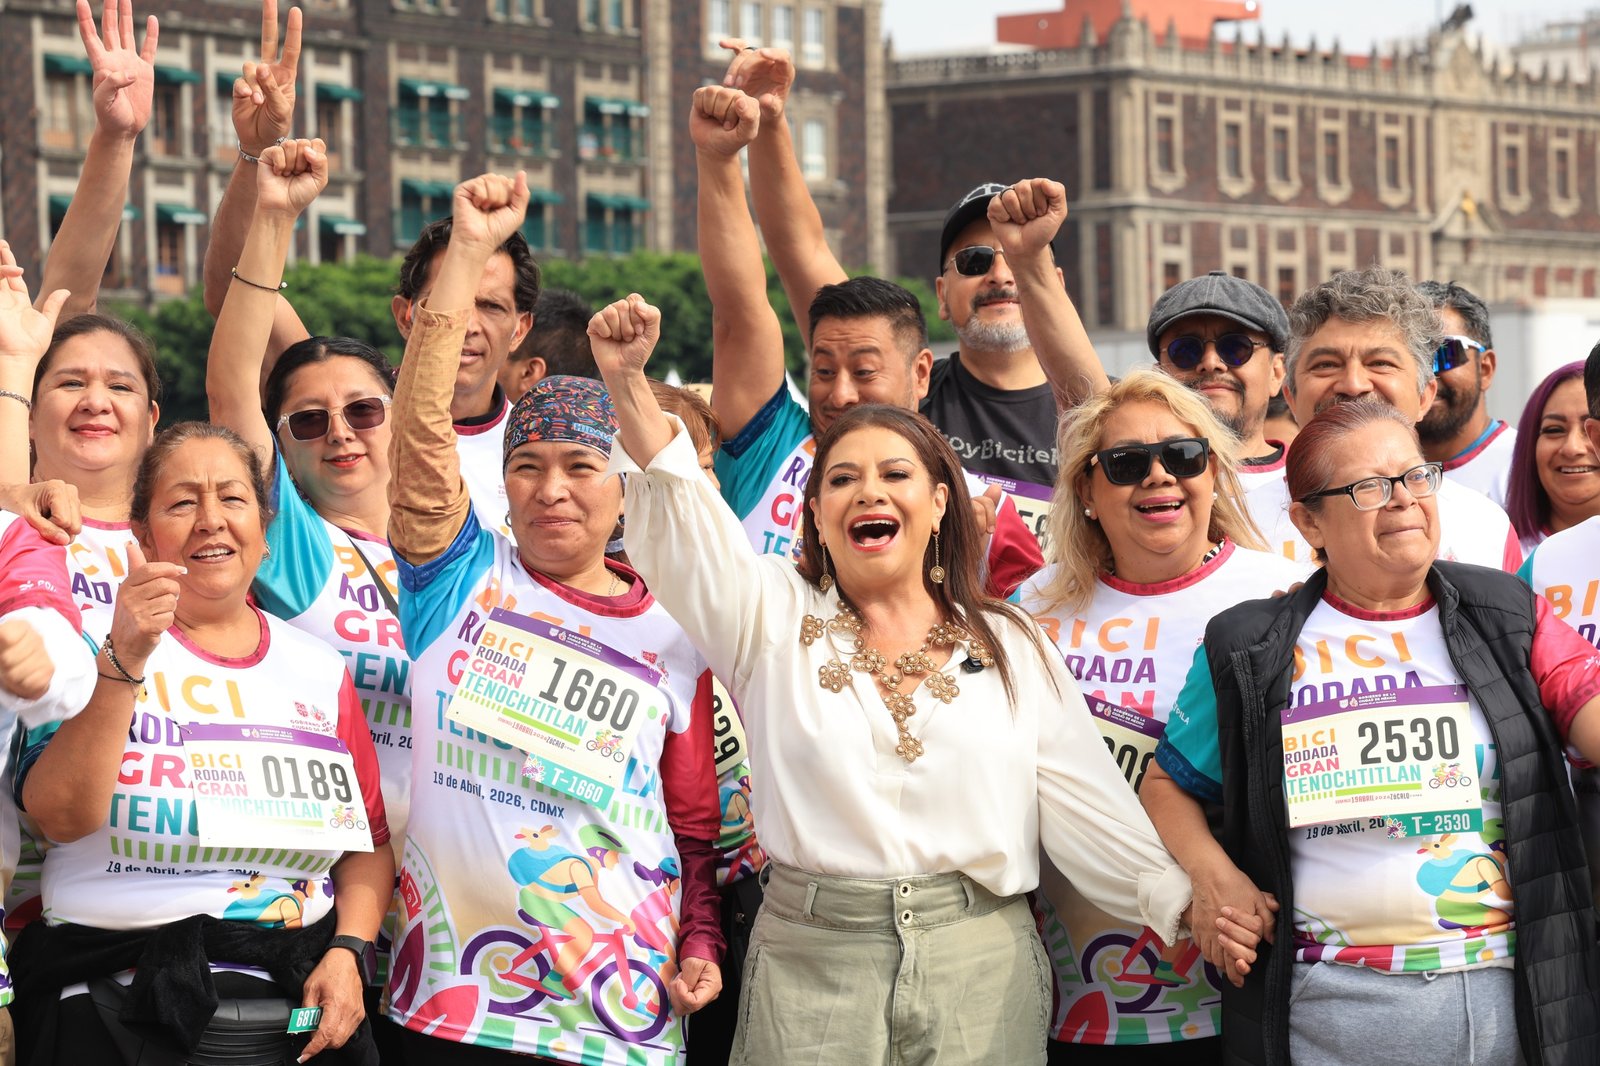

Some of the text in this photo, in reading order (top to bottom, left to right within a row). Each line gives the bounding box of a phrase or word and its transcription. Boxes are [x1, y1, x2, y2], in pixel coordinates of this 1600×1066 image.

[475, 645, 528, 675] RODADA
[481, 631, 534, 662] BICI
[471, 658, 523, 689] GRAN
[464, 671, 589, 737] TENOCHTITLAN
[538, 656, 640, 732] 1660
[1284, 728, 1336, 752] BICI
[1285, 744, 1338, 764] RODADA
[1358, 716, 1460, 765] 2530
[190, 753, 242, 769] BICI
[194, 769, 246, 783] RODADA
[1286, 757, 1340, 777] GRAN
[197, 782, 249, 797] GRAN
[262, 755, 353, 803] 0189
[550, 767, 604, 803] T-1660
[1287, 764, 1422, 795] TENOCHTITLAN
[199, 796, 324, 819] NOCHTITLAN
[433, 771, 565, 819] 19 de Abril, 2026, CDMX
[1306, 826, 1319, 840] 19
[1321, 824, 1334, 836] de
[1336, 820, 1365, 835] Abril,
[106, 861, 121, 873] 19
